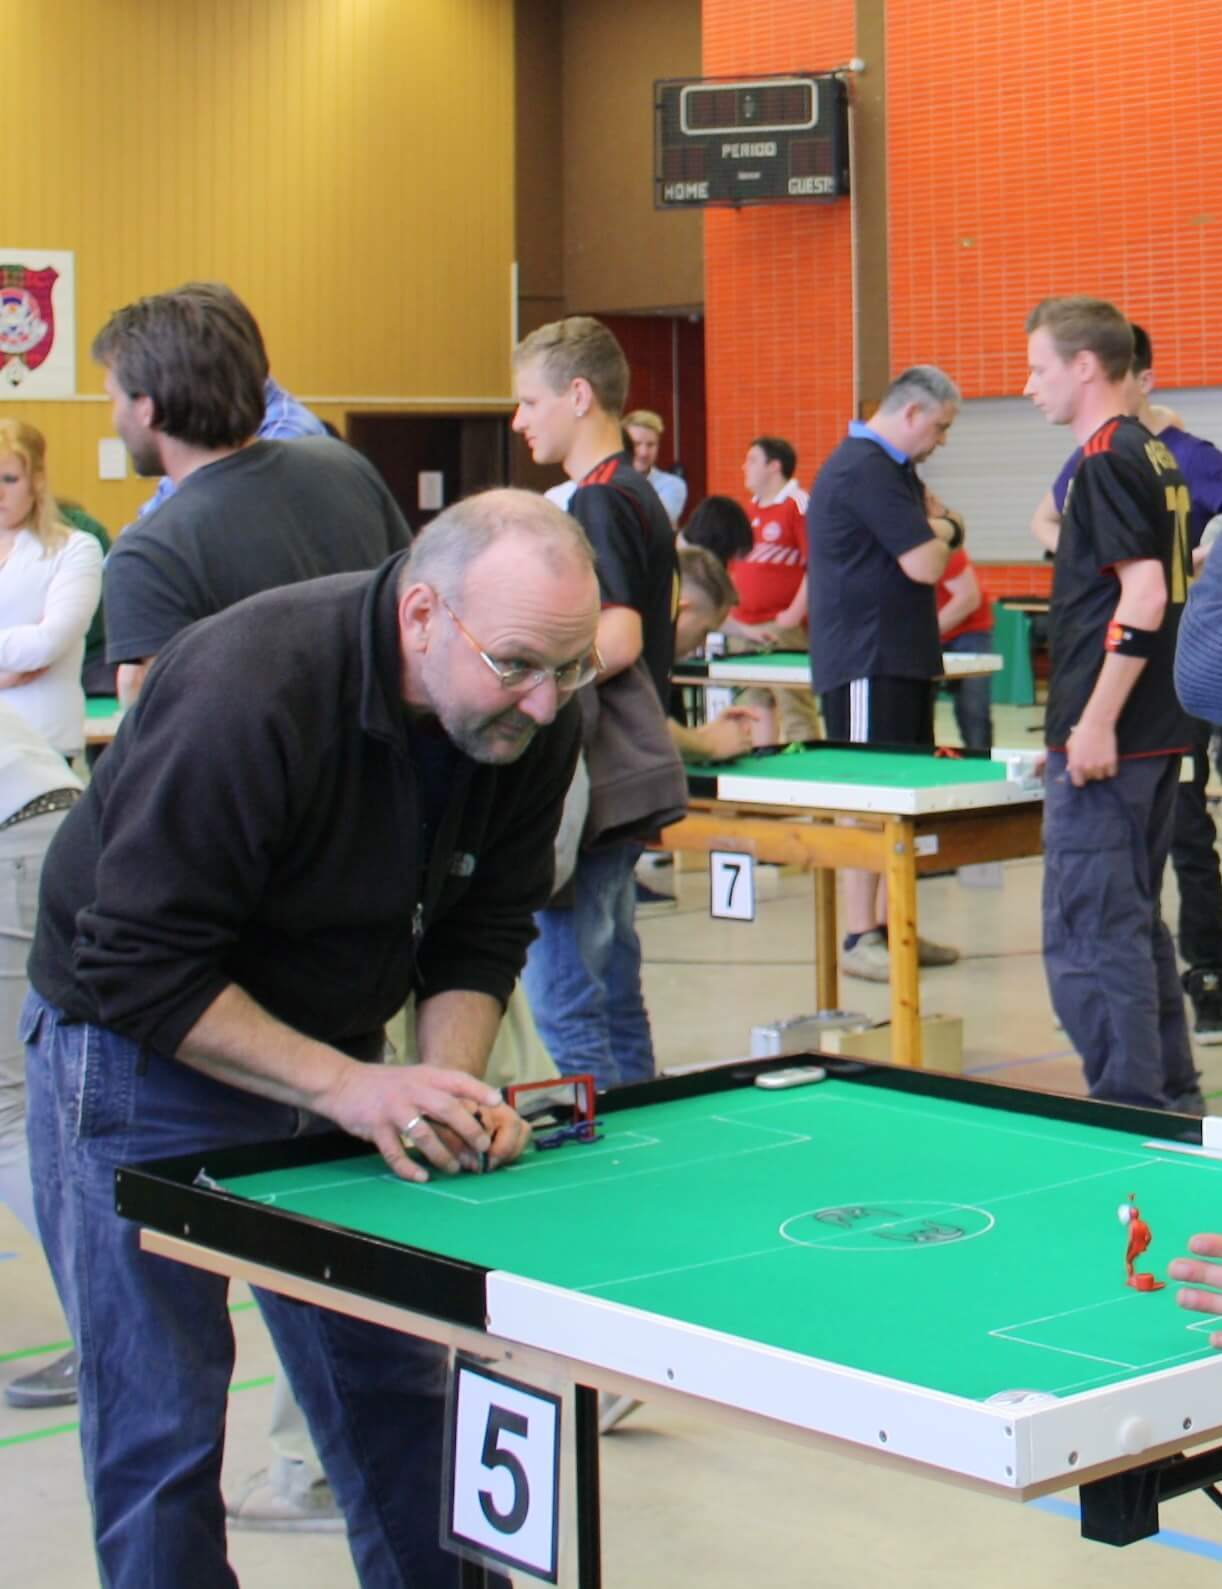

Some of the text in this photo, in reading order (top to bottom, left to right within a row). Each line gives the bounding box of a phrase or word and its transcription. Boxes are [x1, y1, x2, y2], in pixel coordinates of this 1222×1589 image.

[722, 142, 777, 159] PERIOD
[664, 182, 709, 200] HOME
[723, 864, 740, 907] 7
[478, 1403, 530, 1535] 5
